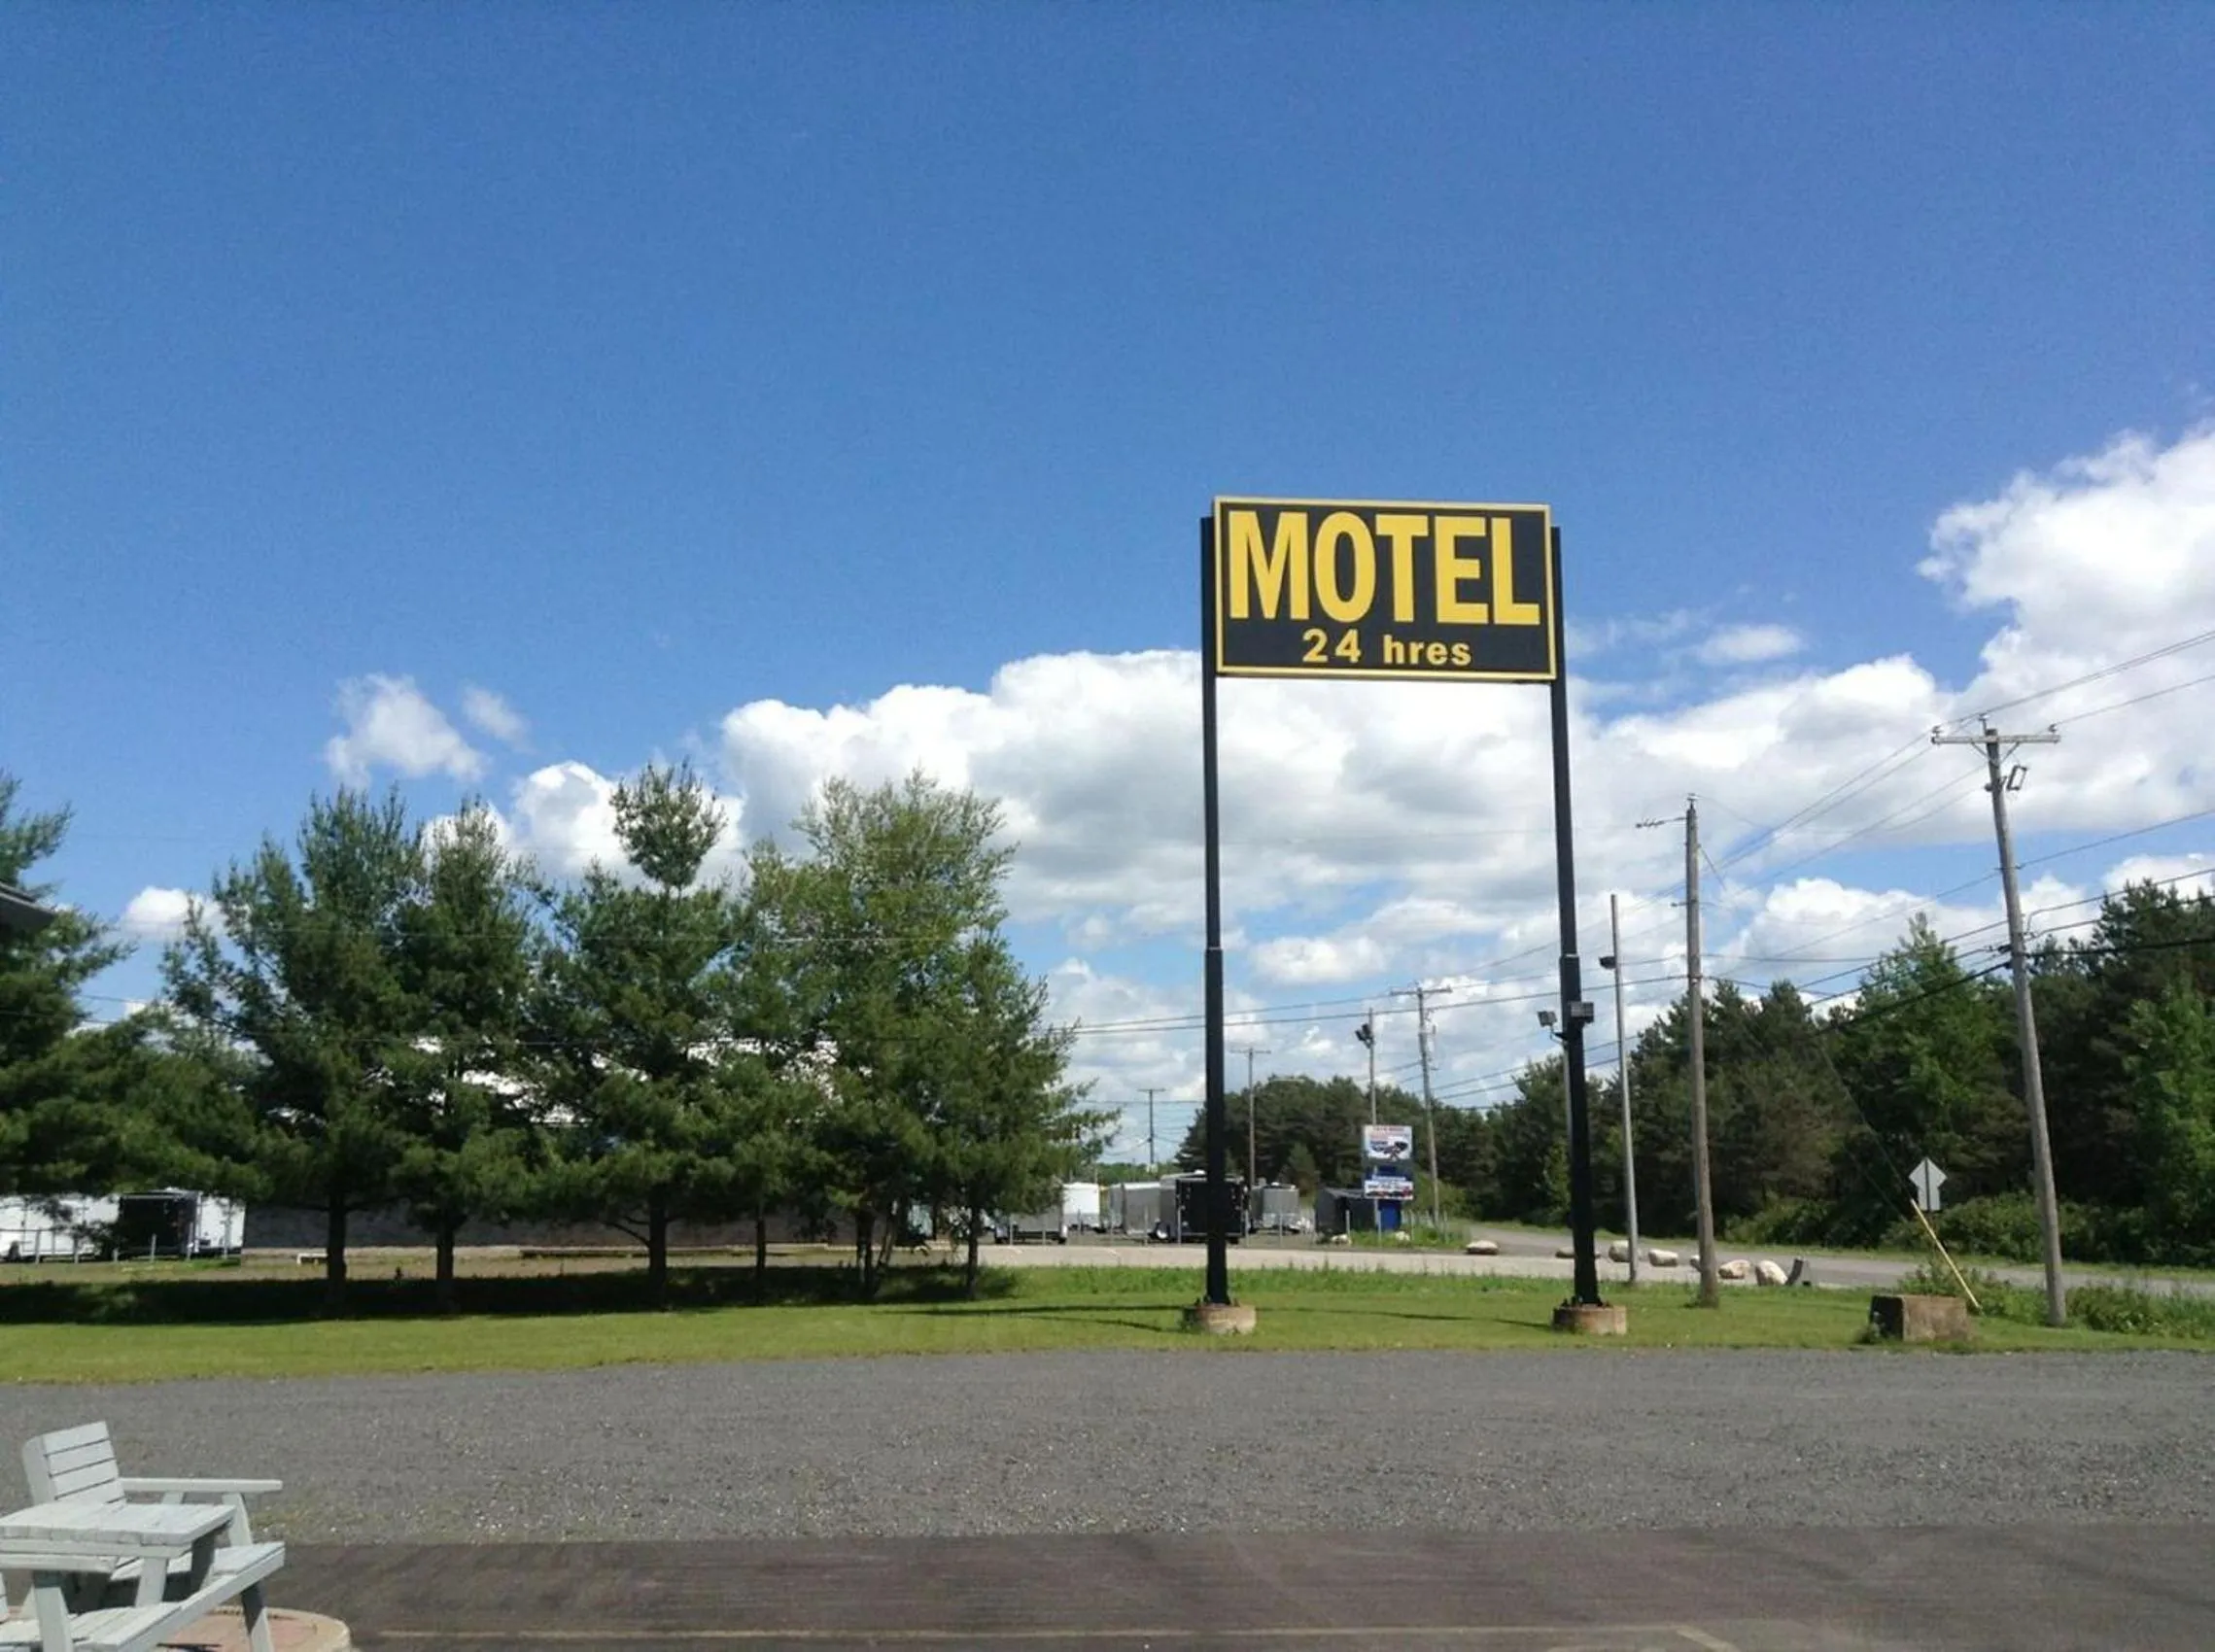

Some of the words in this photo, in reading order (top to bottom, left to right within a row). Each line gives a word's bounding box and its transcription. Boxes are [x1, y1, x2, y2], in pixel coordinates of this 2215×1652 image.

[1228, 510, 1540, 625] MOTEL
[1302, 628, 1362, 663] 24
[1383, 635, 1472, 666] hres
